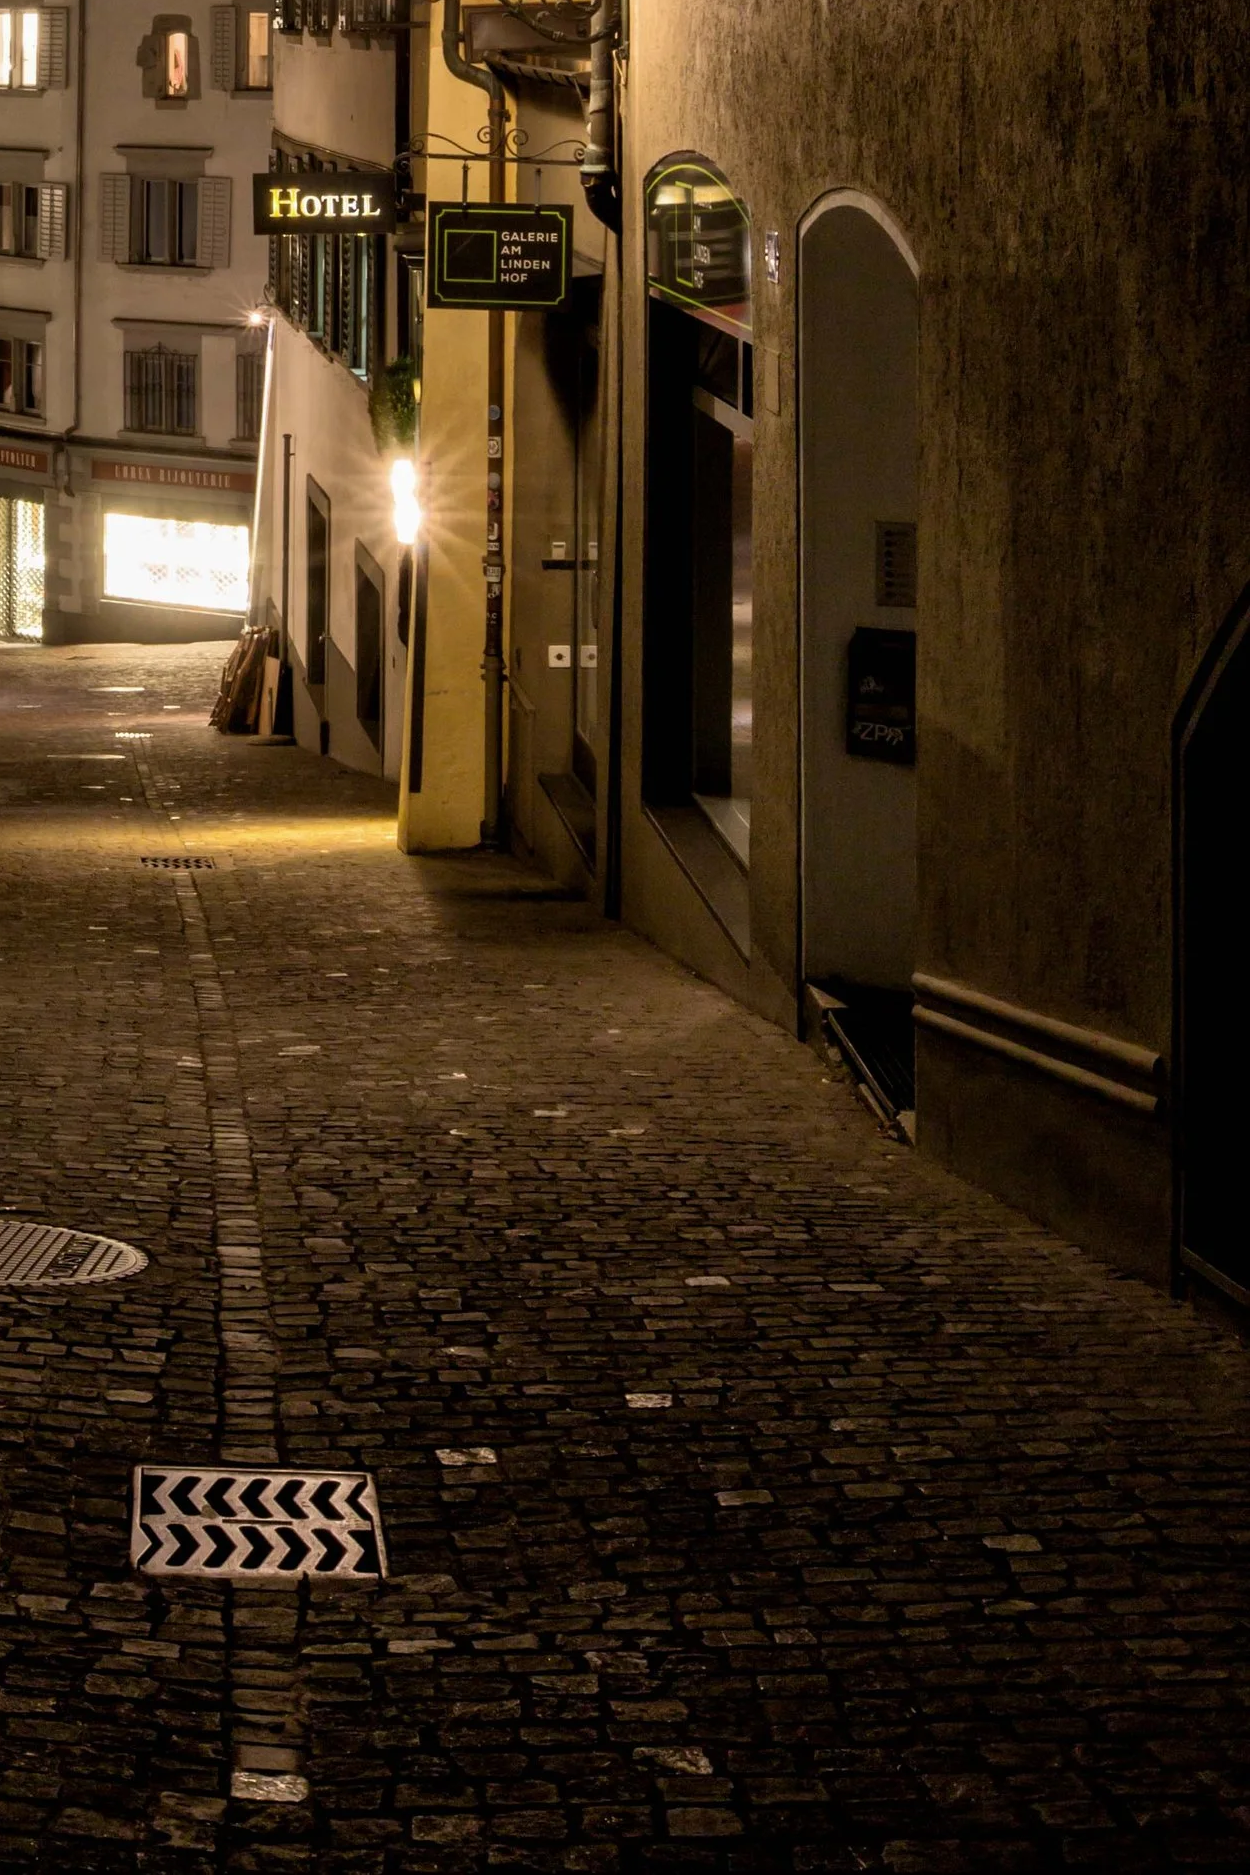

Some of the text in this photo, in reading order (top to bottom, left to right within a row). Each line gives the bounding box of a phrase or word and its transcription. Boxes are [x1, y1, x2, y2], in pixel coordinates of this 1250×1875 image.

[501, 231, 559, 243] GALERIE
[500, 245, 522, 255] AM
[501, 259, 551, 270] LINDEN
[500, 272, 528, 283] HOF
[160, 469, 231, 488] BIJOUTERIE
